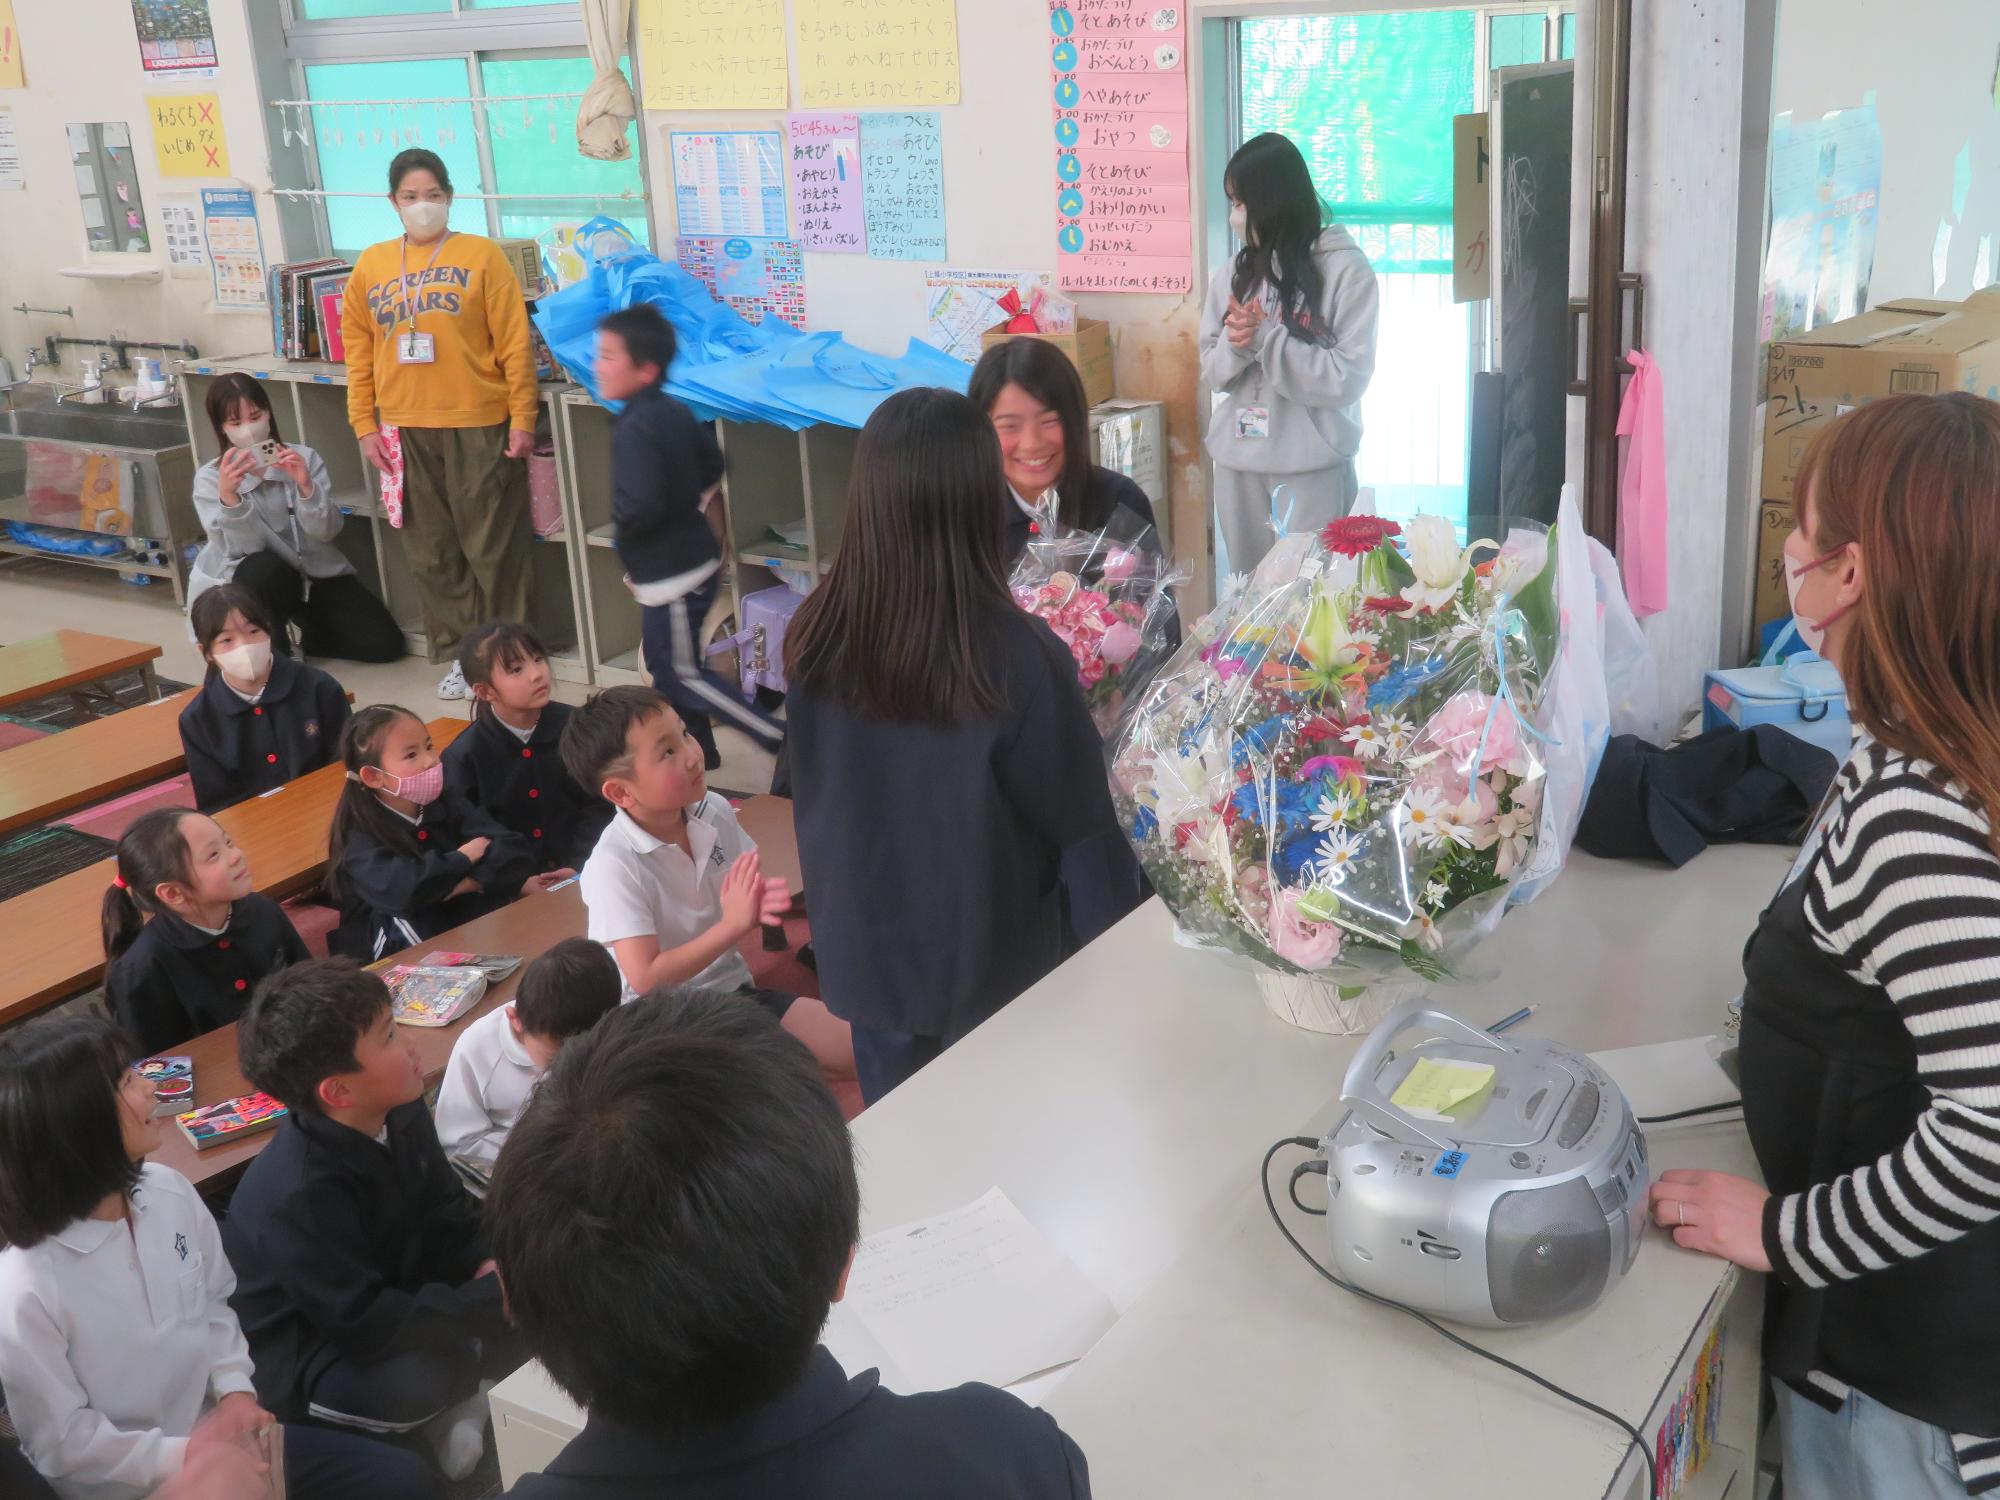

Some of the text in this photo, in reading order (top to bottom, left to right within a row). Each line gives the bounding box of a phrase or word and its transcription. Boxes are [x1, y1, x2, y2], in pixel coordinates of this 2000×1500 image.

[1080, 12, 1148, 30] そとあそび
[1088, 53, 1149, 70] おべんとう
[1083, 88, 1151, 105] へやあそび
[904, 115, 934, 128] つくえ
[1083, 111, 1134, 123] おかたづけ
[904, 133, 939, 151] あそび
[1093, 127, 1136, 147] おやつ
[163, 137, 195, 155] いじめ
[793, 143, 830, 160] あそび
[866, 154, 893, 166] オセロ
[867, 167, 899, 180] トランプ
[1087, 162, 1152, 181] そとあそび
[1089, 199, 1166, 217] おわりのかい
[1089, 239, 1137, 252] おむかえ
[367, 266, 472, 311] SCREEN
[377, 292, 460, 340] STARS
